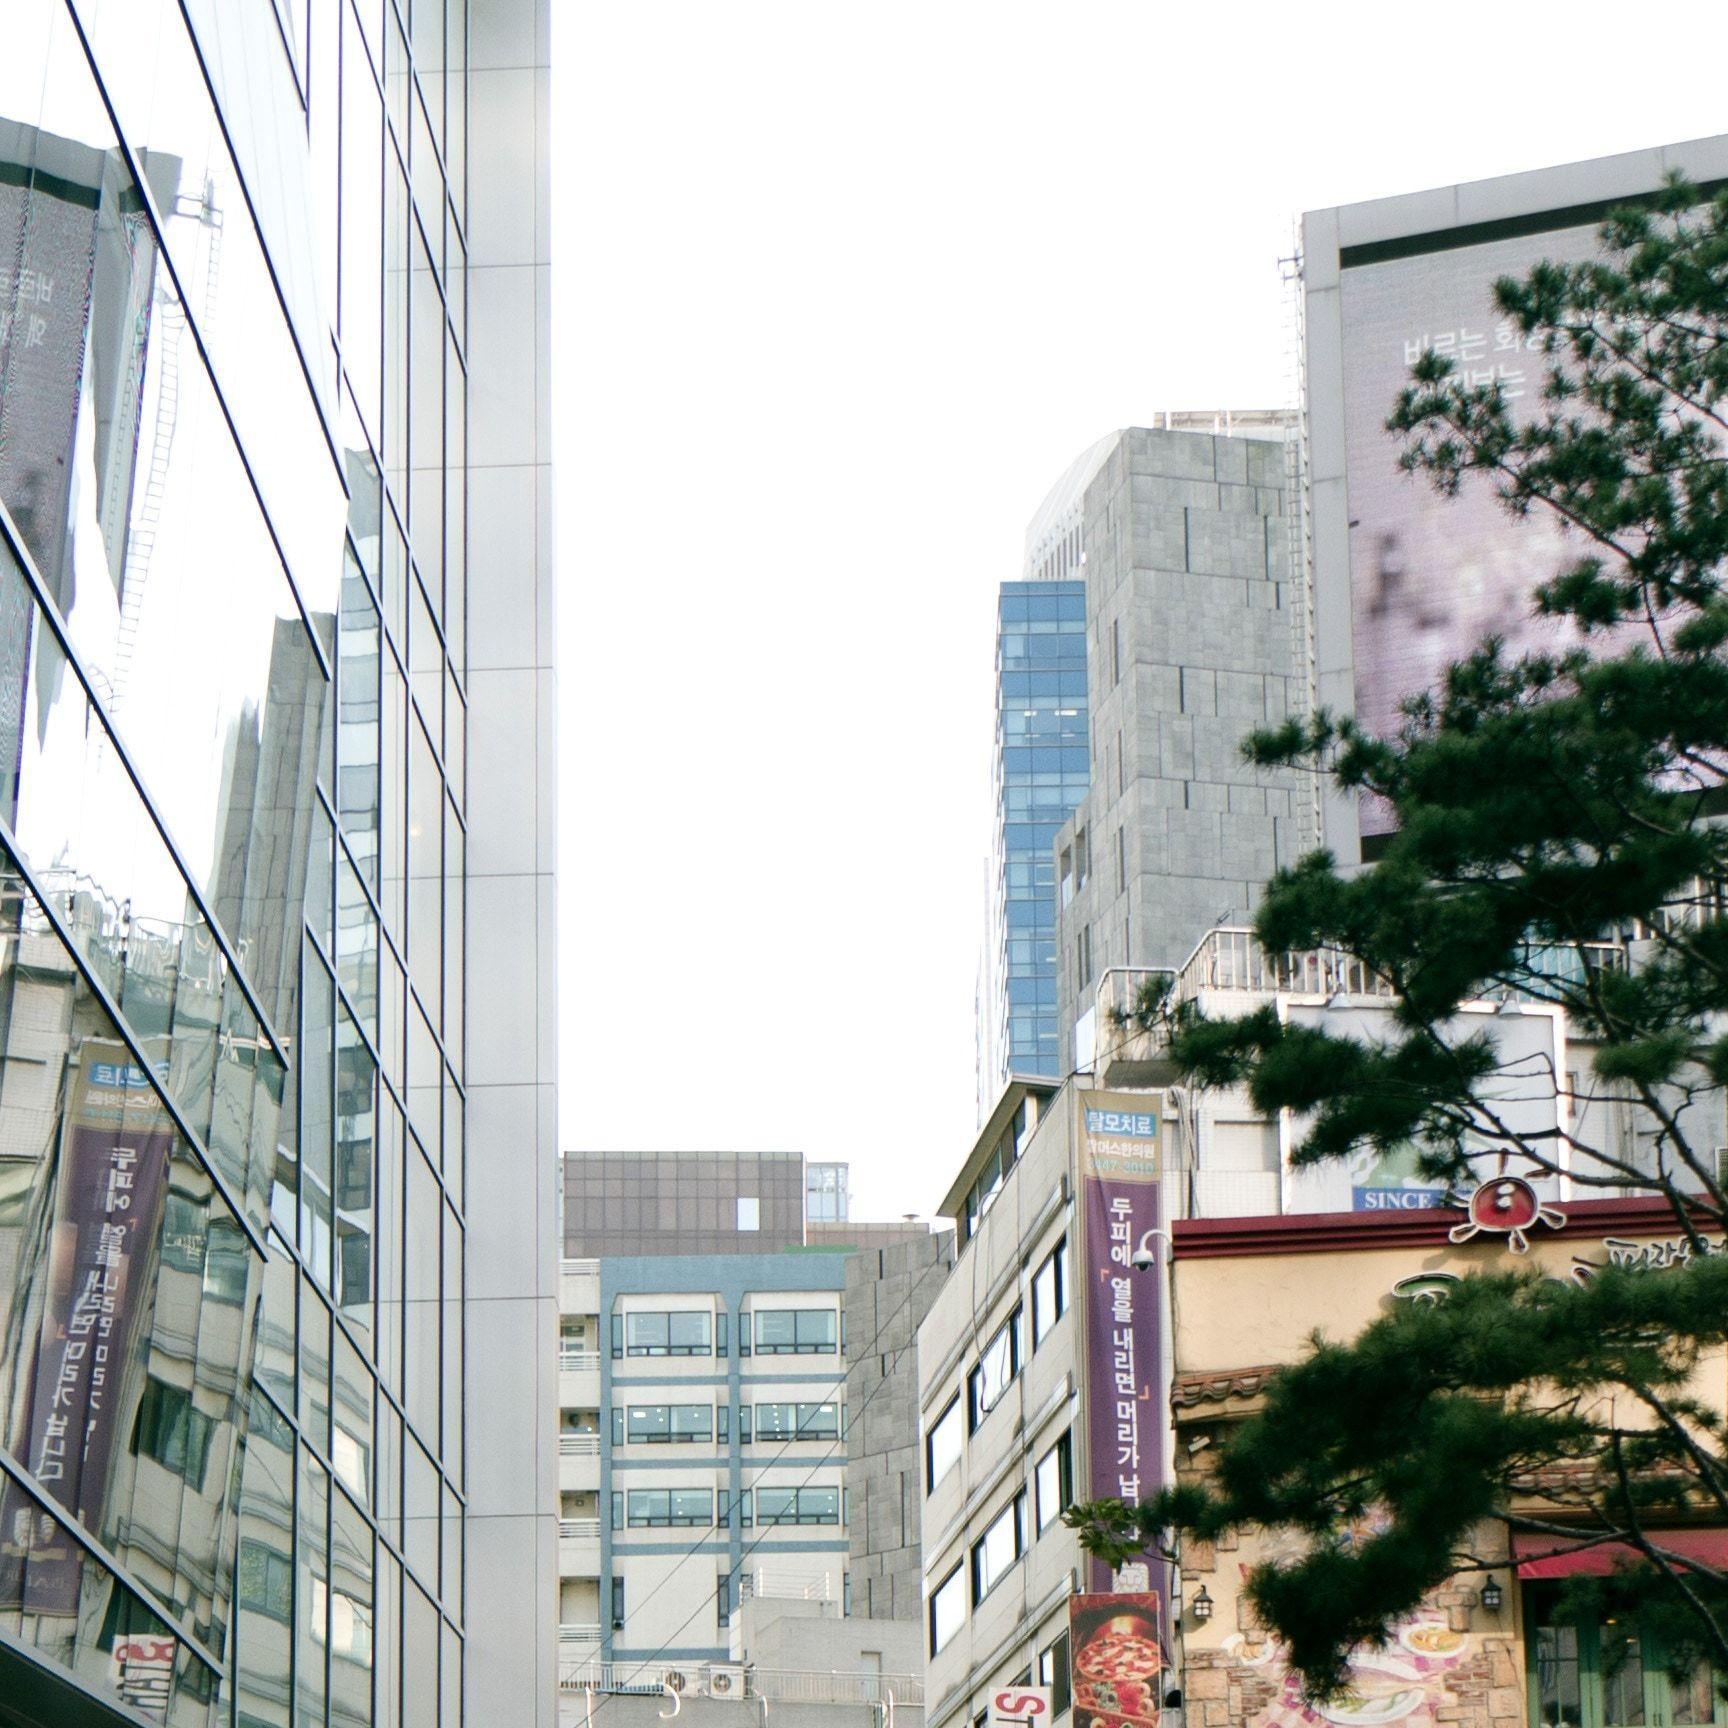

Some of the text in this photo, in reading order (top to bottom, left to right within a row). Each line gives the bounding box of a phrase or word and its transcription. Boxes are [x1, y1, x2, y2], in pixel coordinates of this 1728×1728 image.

[1108, 1197, 1132, 1268] 두피에
[1364, 1190, 1432, 1211] SINCE
[1110, 1276, 1133, 1324] 열을
[1113, 1330, 1136, 1395] 내리면
[1116, 1399, 1141, 1470] 머리가
